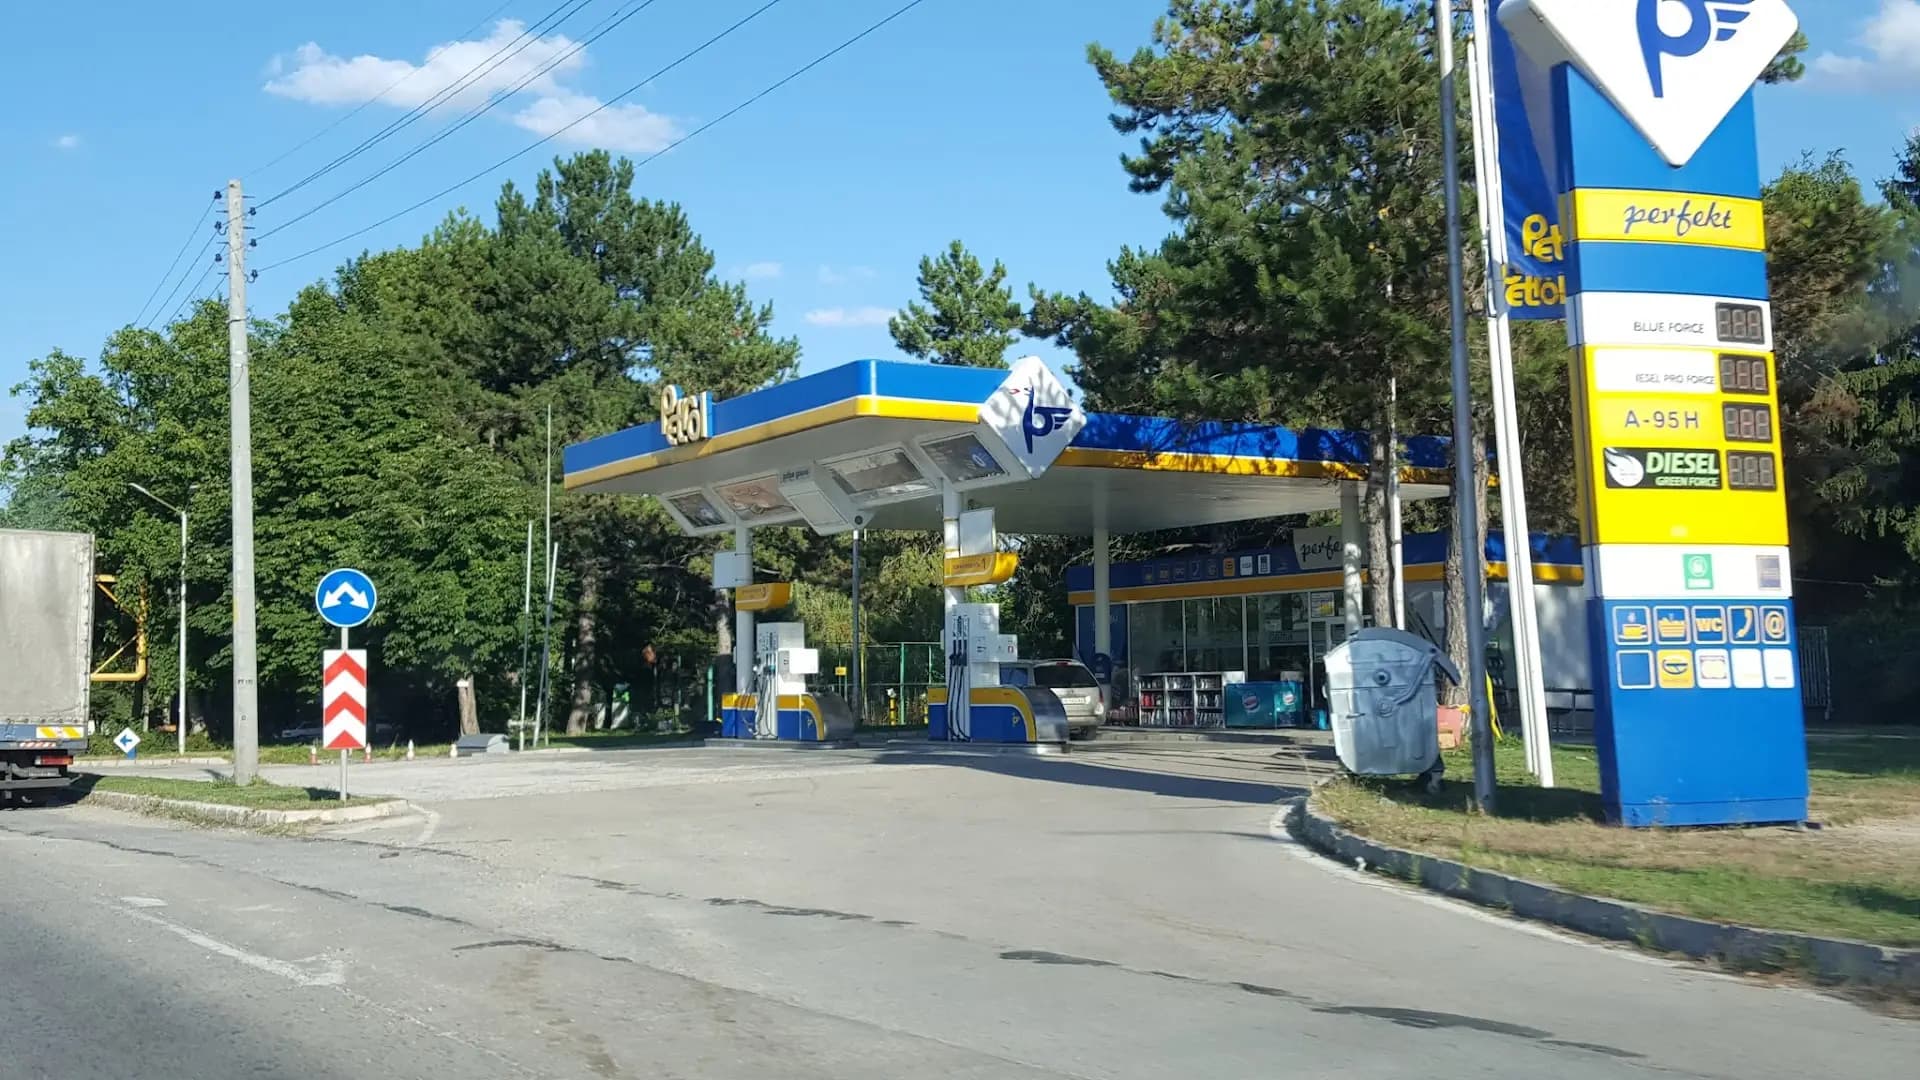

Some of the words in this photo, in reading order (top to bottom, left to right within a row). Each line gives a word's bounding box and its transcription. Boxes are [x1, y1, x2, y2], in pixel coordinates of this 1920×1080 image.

[1624, 199, 1732, 236] perfekt
[1633, 321, 1664, 332] BLUE
[1668, 322, 1704, 334] FORCE
[1686, 375, 1715, 385] FORCE
[660, 385, 708, 446] Petrol
[1645, 451, 1719, 475] DIESEL
[1655, 475, 1688, 486] GREEN
[1689, 477, 1719, 488] FORCE
[1695, 617, 1723, 632] WC
